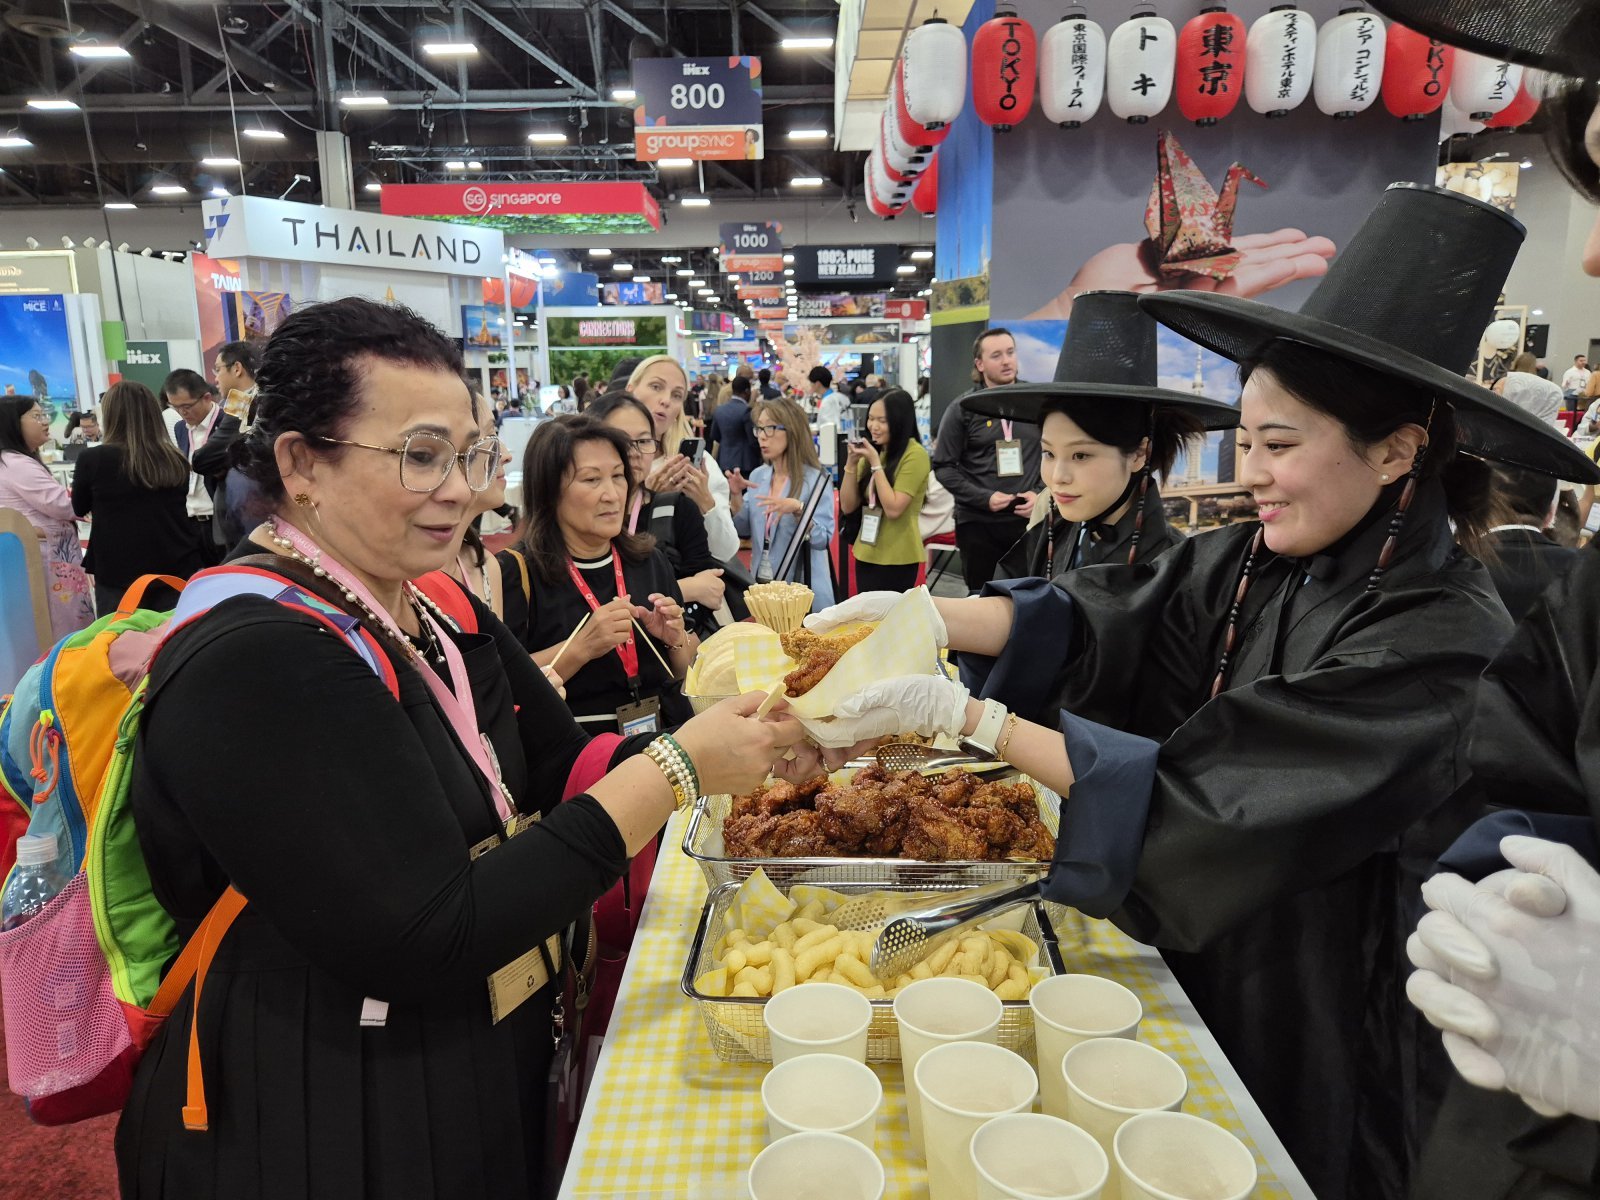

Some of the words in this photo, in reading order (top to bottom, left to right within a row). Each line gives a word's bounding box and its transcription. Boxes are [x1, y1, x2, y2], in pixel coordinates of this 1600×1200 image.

[999, 22, 1021, 110] TOKYO
[1067, 23, 1088, 108] 東京国際フォーラム
[1131, 26, 1158, 96] トキ
[1197, 24, 1233, 96] 東京
[670, 83, 725, 109] 800
[646, 134, 735, 154] groupSYNC
[282, 217, 481, 264] THAILAND
[733, 233, 769, 248] 1000
[847, 249, 875, 264] PURE
[748, 271, 775, 281] 1200
[818, 264, 837, 275] NEW
[838, 263, 875, 275] ZEALAND
[799, 309, 832, 317] AFRICA
[800, 300, 832, 309] SOUTH
